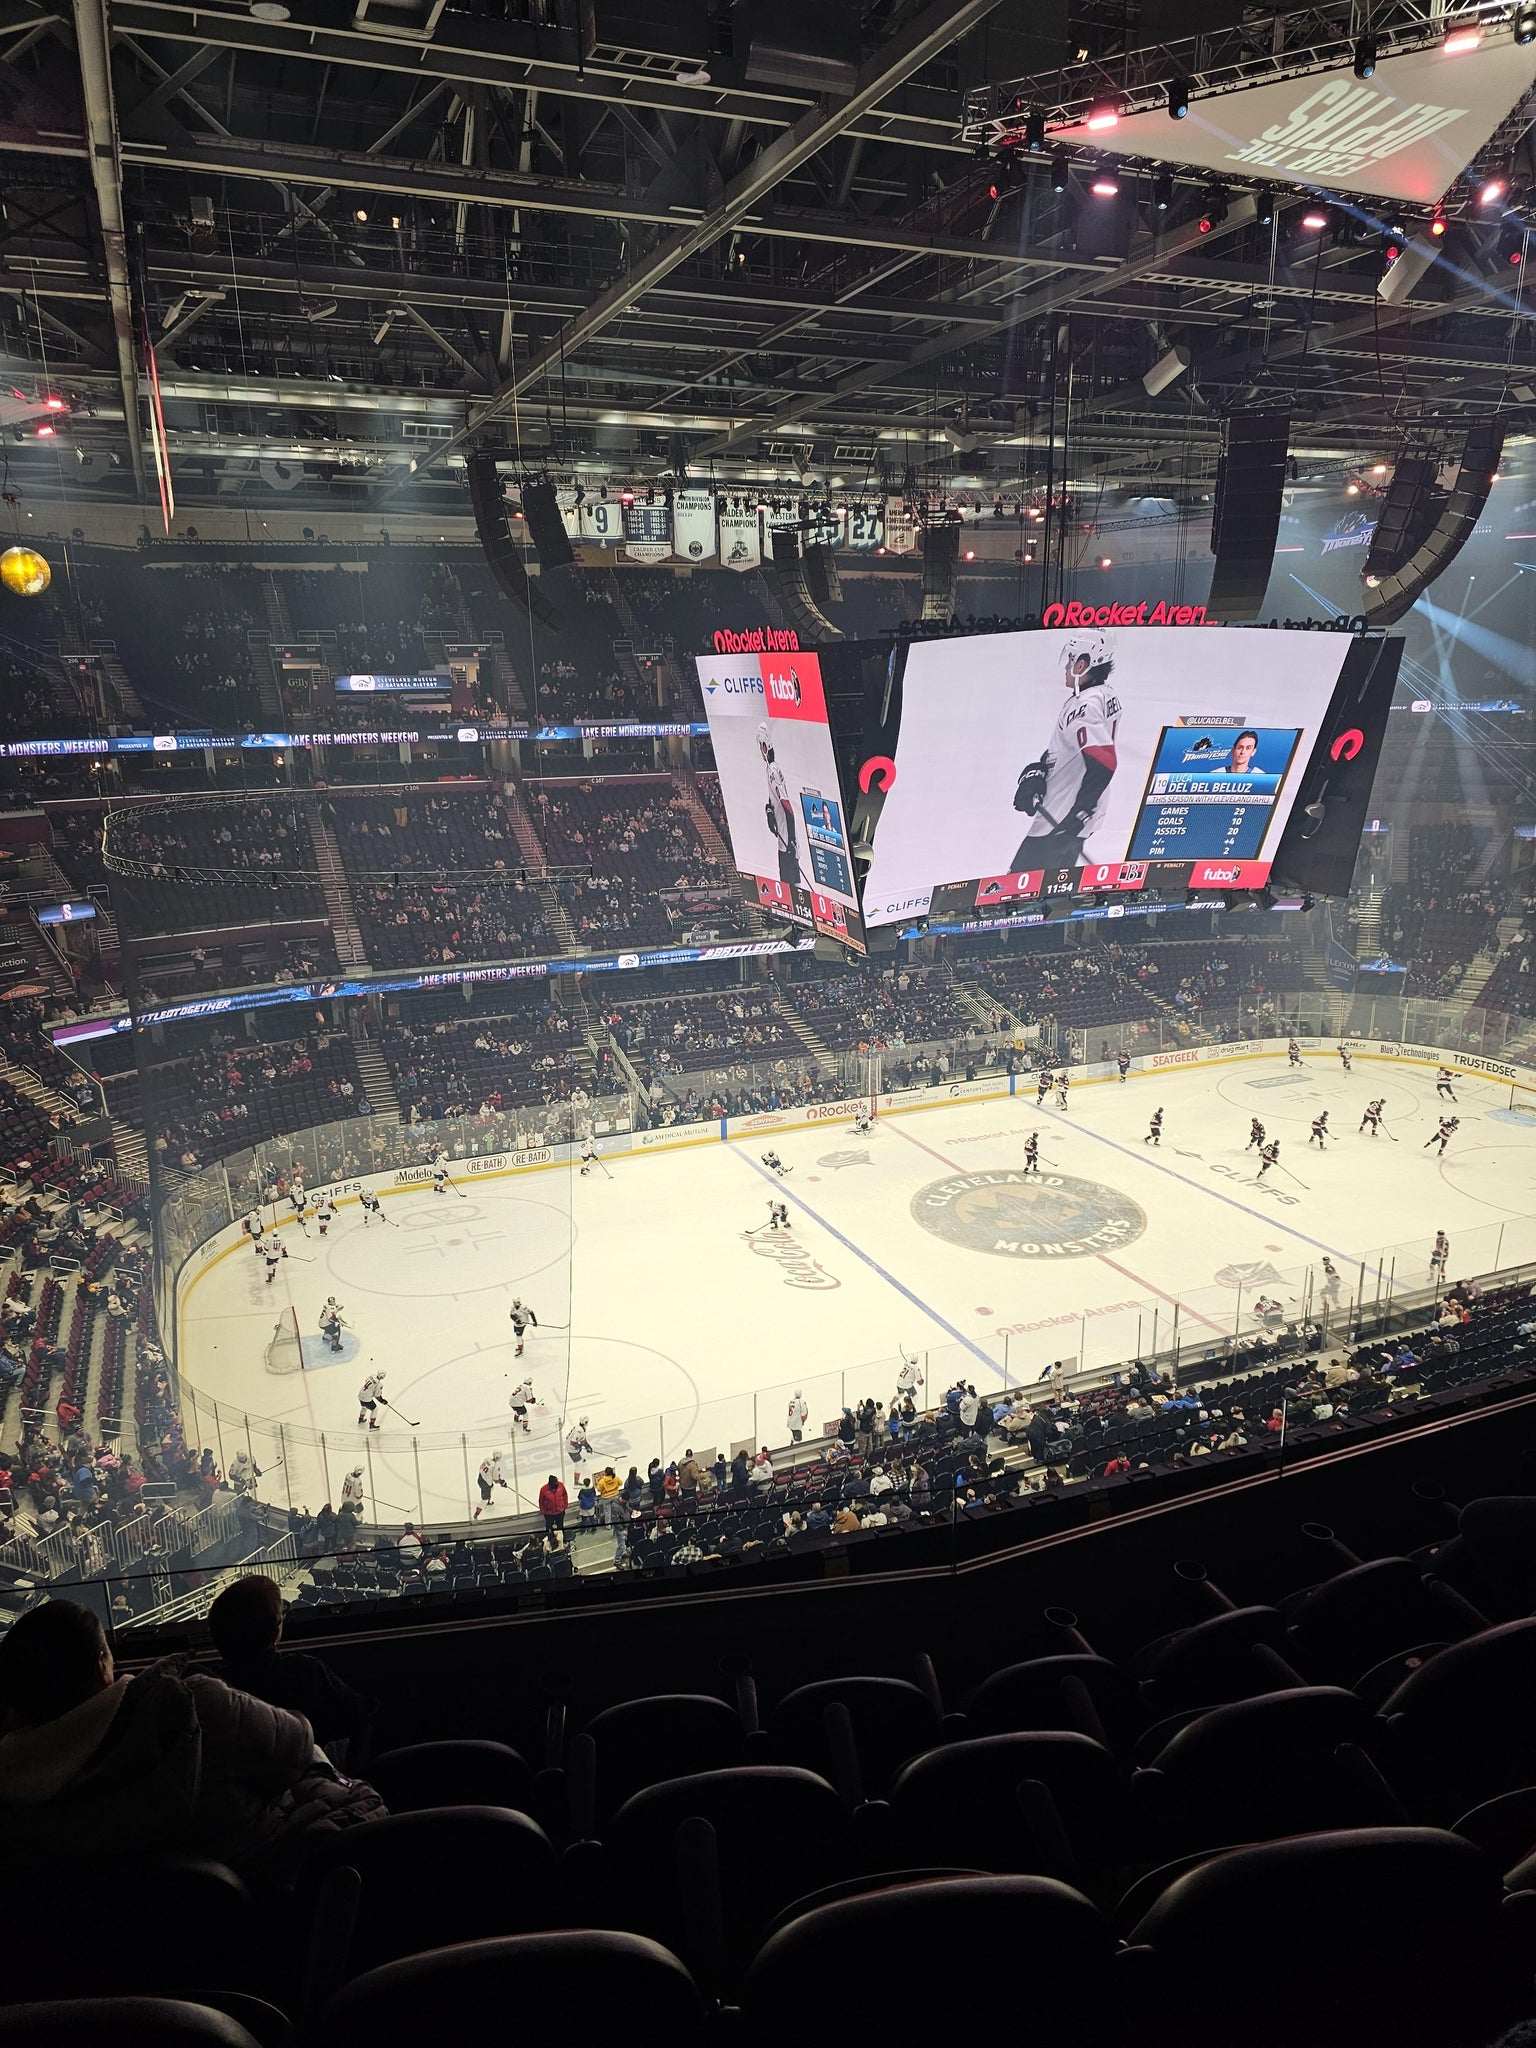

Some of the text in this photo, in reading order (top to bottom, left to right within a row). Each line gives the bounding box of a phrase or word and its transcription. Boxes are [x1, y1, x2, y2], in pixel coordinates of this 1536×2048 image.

[1261, 78, 1471, 160] DEPTHS
[676, 501, 712, 511] CHAMPIONS
[595, 506, 609, 533] 9
[721, 519, 757, 528] CHAMPIONS
[852, 515, 878, 540] 27
[1064, 600, 1219, 627] Rocket Aren
[723, 625, 799, 653] Rocket Arena
[724, 677, 764, 694] CLIFFS
[769, 672, 795, 700] fubo
[1187, 716, 1238, 726] @LUCADELBEL_
[288, 731, 419, 747] LAKE ERIE MONSTERS WEEKEND
[581, 724, 691, 738] LAKE ERIE MONSTERS WEEKEND
[8, 740, 109, 756] MONSTERS WEEKEND
[1157, 779, 1168, 788] 10
[1171, 774, 1193, 783] LUCA
[1168, 782, 1253, 793] DEL BEL BELLUZ
[1152, 796, 1168, 804] THIS
[1167, 796, 1195, 804] SEASON
[1195, 796, 1213, 804] WITH
[1213, 796, 1251, 804] CLEVELAND
[1161, 807, 1246, 816] GAMES 29
[1158, 817, 1243, 825] GOALS 10
[1154, 827, 1240, 836] ASSISTS 20
[1149, 847, 1230, 855] PIM 2
[1097, 865, 1110, 881] 0
[1203, 868, 1233, 882] fubo
[1017, 873, 1030, 890] 0
[1047, 882, 1074, 894] 11:54
[774, 881, 783, 899] 0
[795, 903, 813, 920] 11:54
[819, 896, 827, 914] 0
[886, 896, 931, 913] CLIFFS
[1328, 958, 1356, 971] LECOM
[418, 964, 547, 986] LAKE ERIE MONSTERS WEEKEND
[1220, 1045, 1235, 1054] drug
[1399, 1047, 1440, 1061] Technologies
[1152, 1050, 1199, 1068] SEATGEEK
[1453, 1054, 1517, 1079] TRUSTEDSEC
[819, 1100, 863, 1119] Rocket
[654, 1127, 709, 1141] MEDICAL MUTUAL
[399, 1168, 433, 1184] Modelo
[926, 1174, 1064, 1208] CLEVELAND
[1209, 1164, 1301, 1206] CLIFFS
[993, 1218, 1131, 1255] MONSTERS
[1014, 1300, 1140, 1334] Rocket Arena
[900, 1367, 910, 1379] 21
